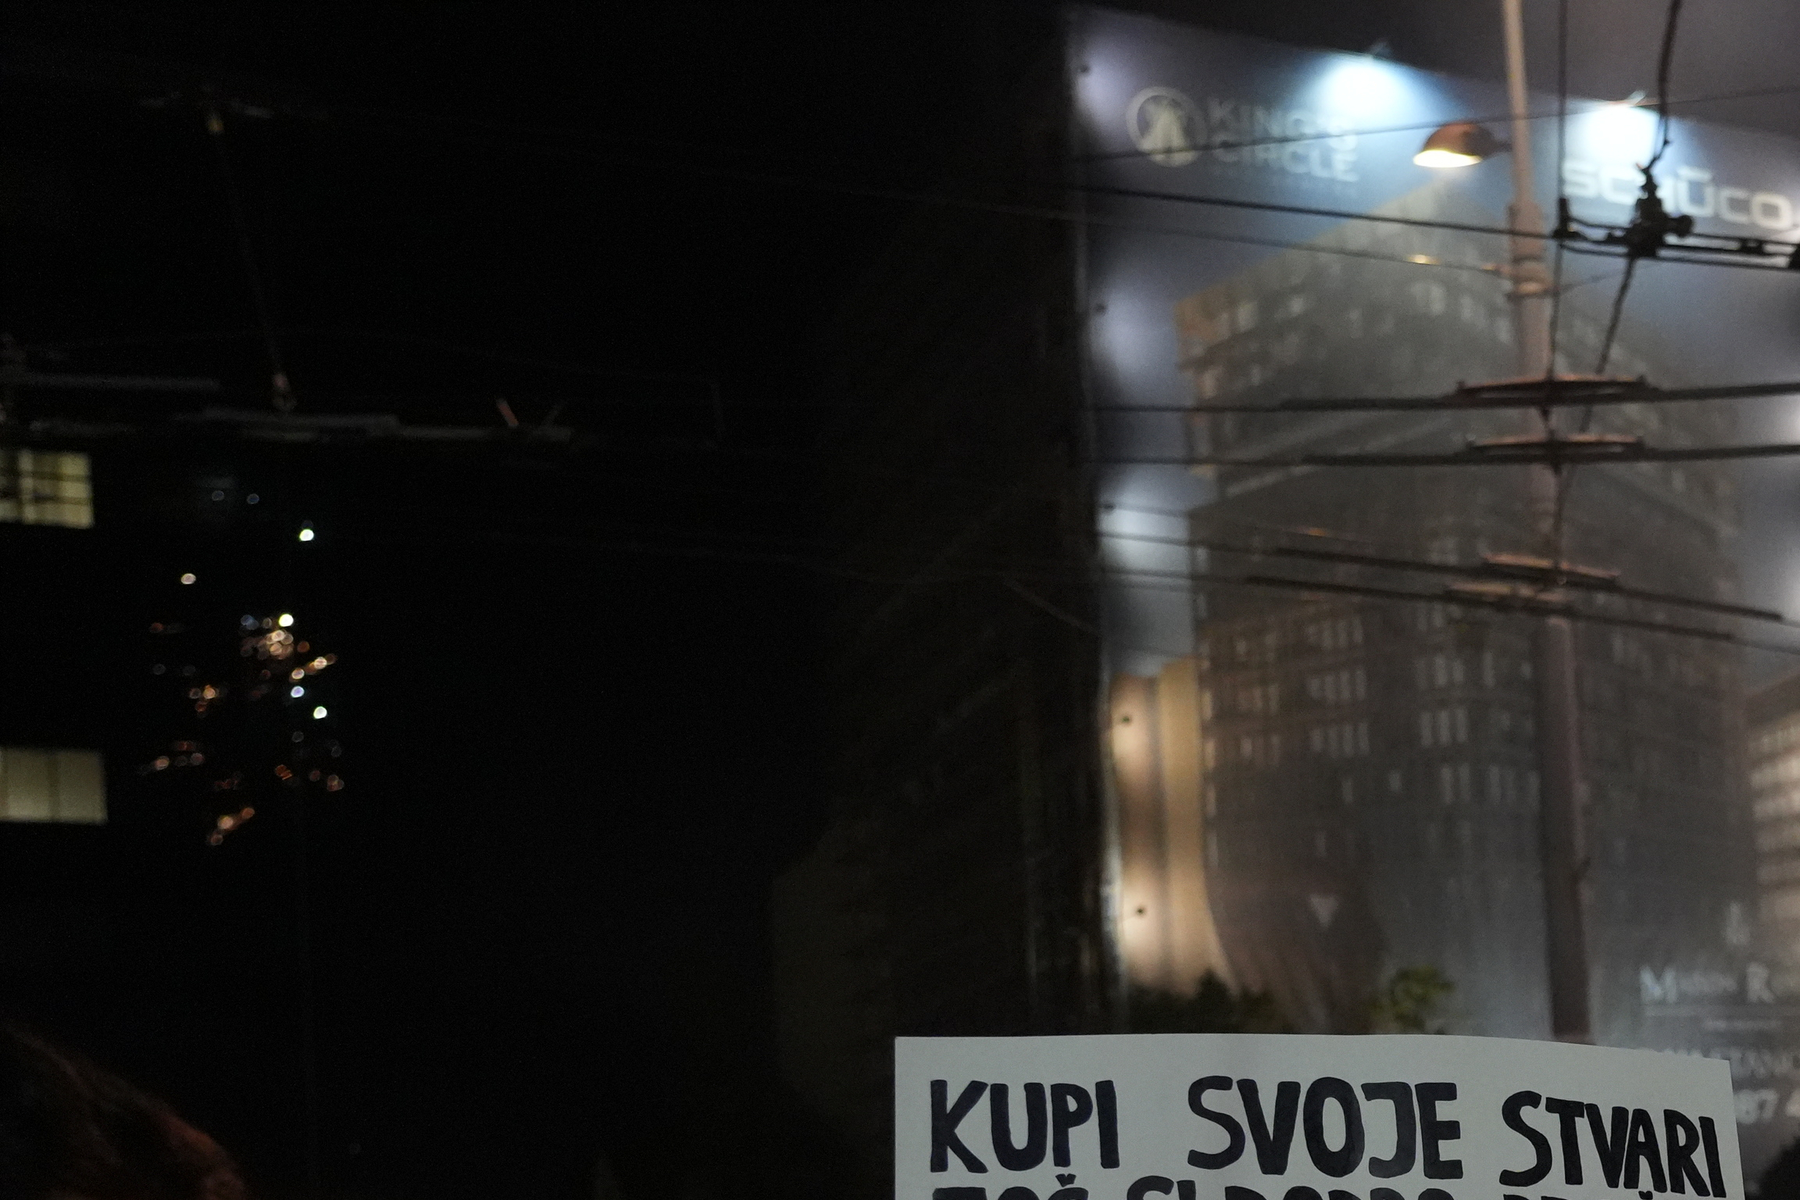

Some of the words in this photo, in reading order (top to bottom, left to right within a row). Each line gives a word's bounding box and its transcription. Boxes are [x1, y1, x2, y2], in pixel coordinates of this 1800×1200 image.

[1206, 97, 1358, 151] KINGS
[930, 1079, 1120, 1174] KUPI
[1187, 1076, 1464, 1180] SVOJE
[1499, 1091, 1727, 1199] STVARI
